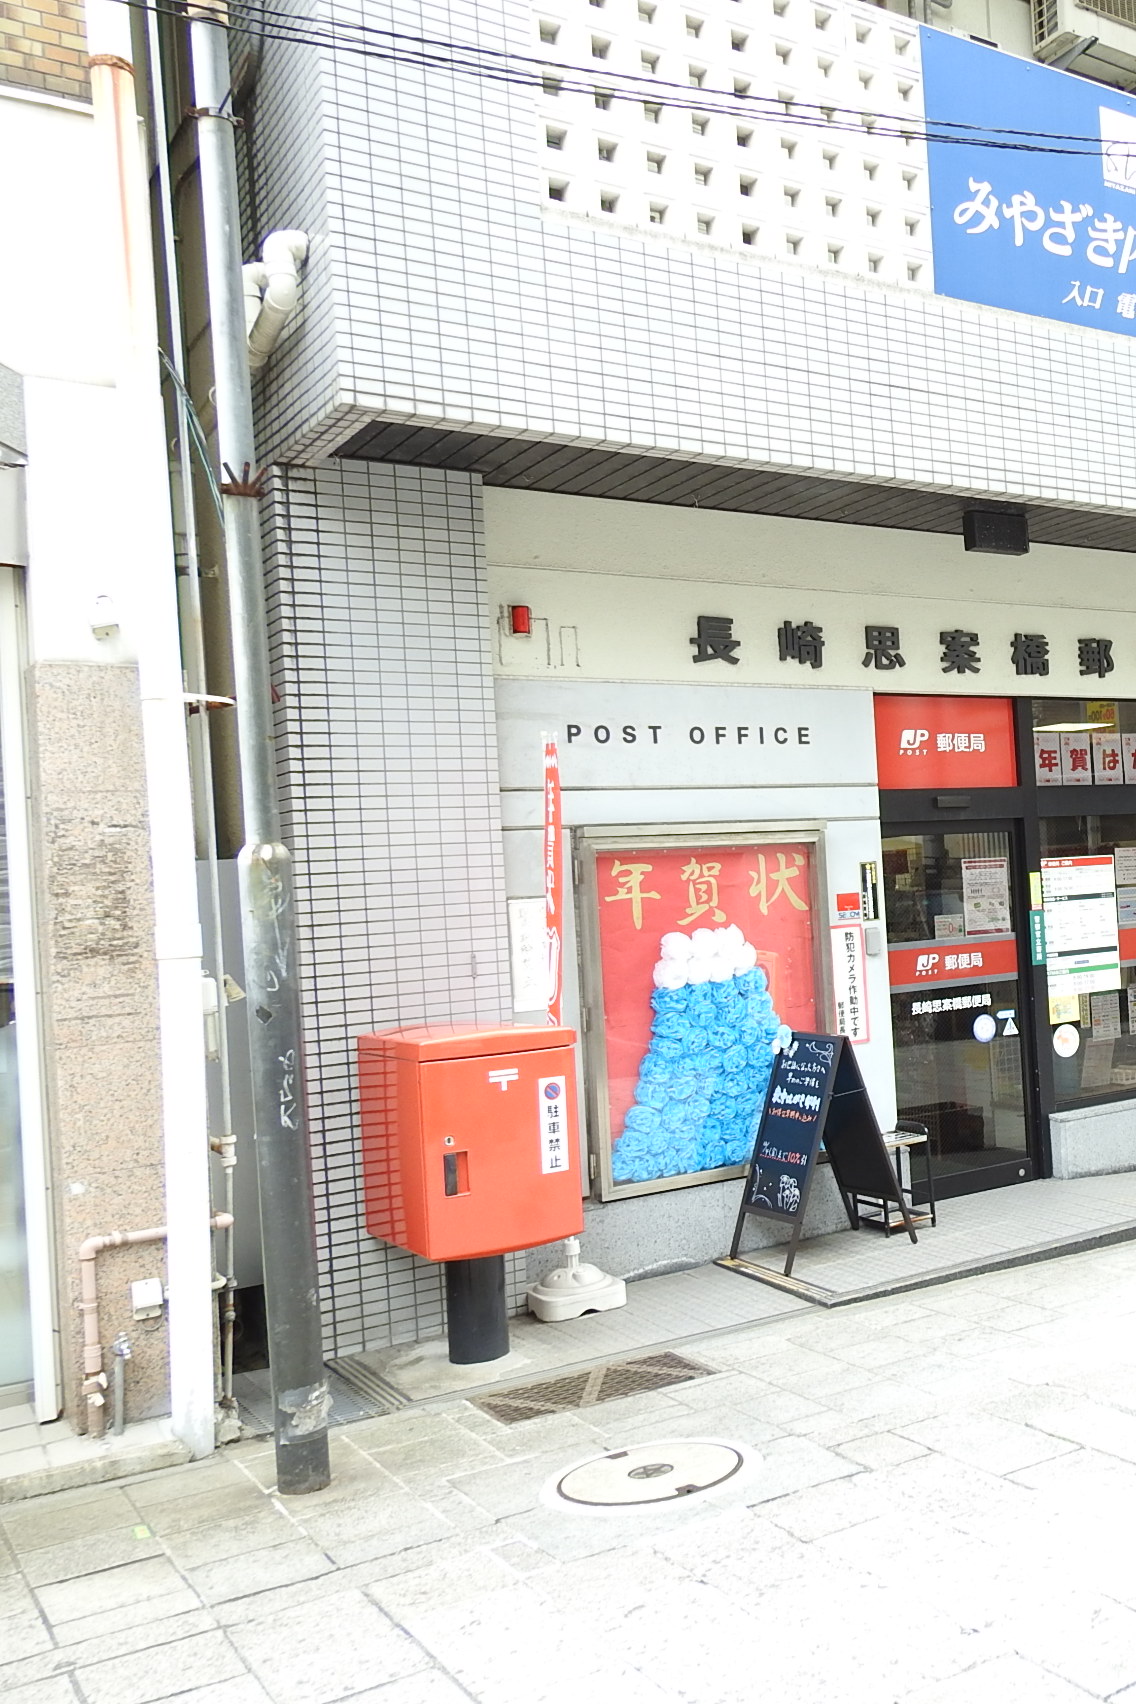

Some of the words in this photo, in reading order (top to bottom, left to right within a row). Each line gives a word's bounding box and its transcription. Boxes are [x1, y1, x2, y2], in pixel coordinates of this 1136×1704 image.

[1062, 281, 1104, 310] 入口
[567, 724, 663, 745] POST
[689, 726, 812, 745] OFFICE
[936, 732, 986, 754] 郵便局
[604, 852, 809, 930] 年賀状
[944, 952, 983, 971] 郵便局
[844, 931, 860, 1038] 防犯カメラ作動中です
[911, 993, 992, 1016] 長崎思案橋郵便局
[546, 1105, 562, 1170] 駐車禁止
